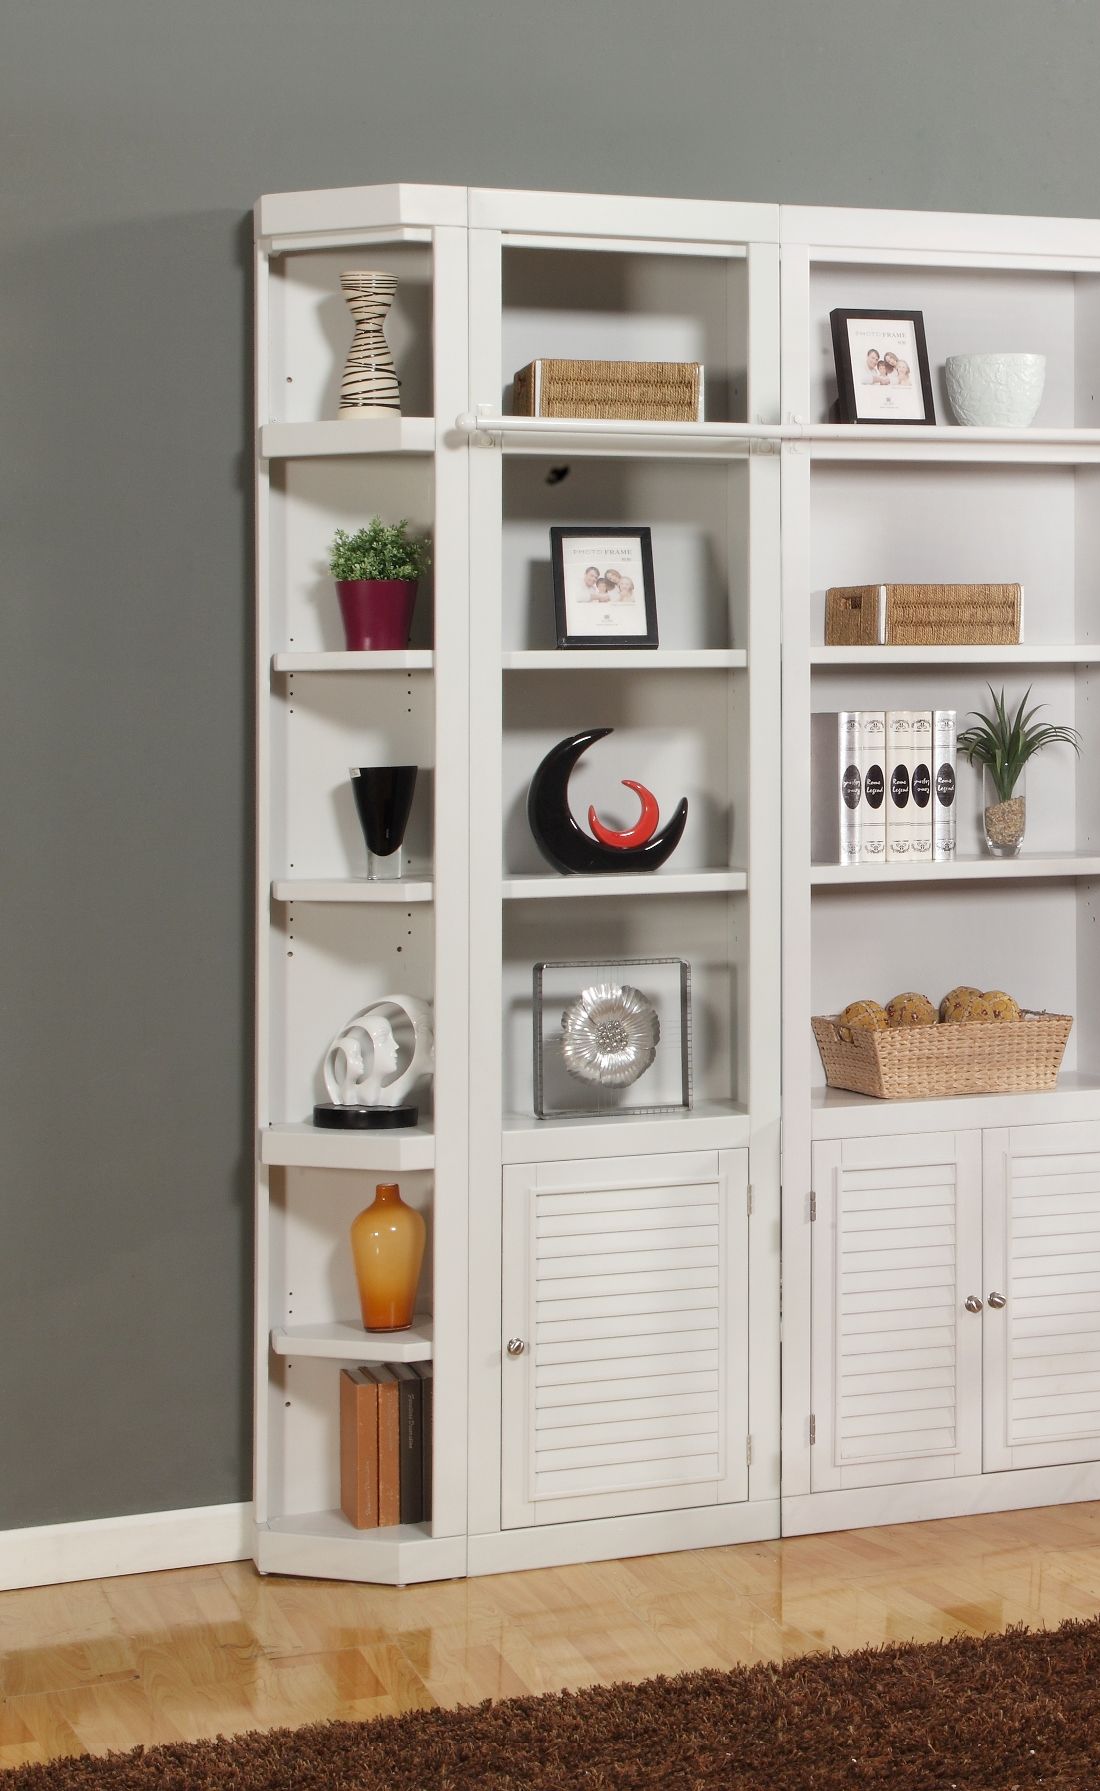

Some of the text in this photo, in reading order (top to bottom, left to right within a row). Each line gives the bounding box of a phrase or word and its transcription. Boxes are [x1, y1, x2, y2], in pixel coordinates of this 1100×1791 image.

[866, 786, 884, 795] Legend
[892, 786, 909, 794] Legend
[937, 784, 955, 793] Legend
